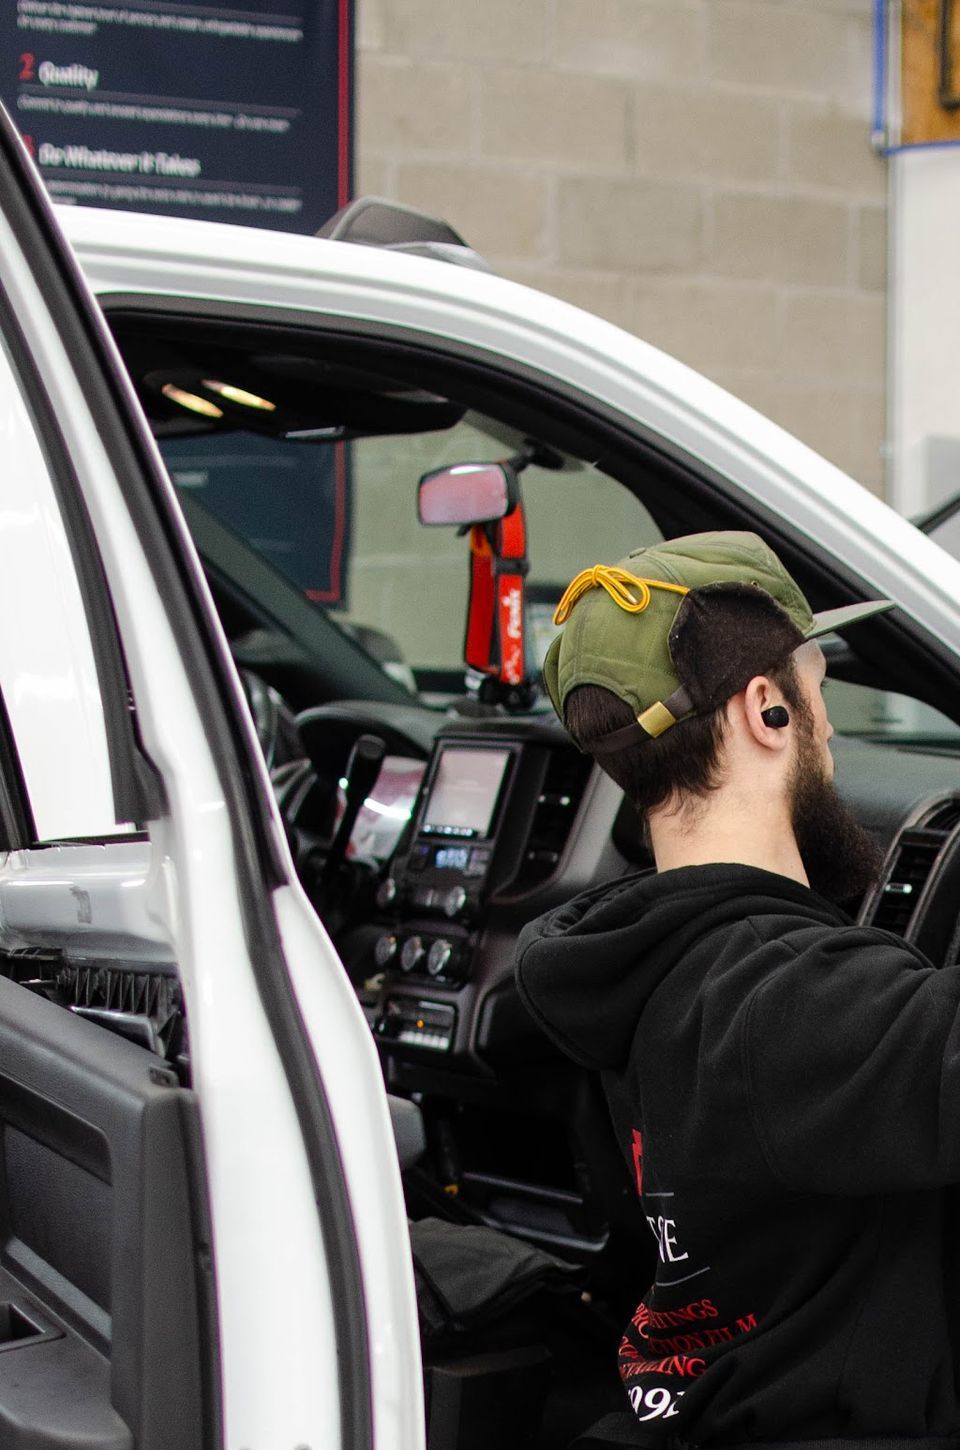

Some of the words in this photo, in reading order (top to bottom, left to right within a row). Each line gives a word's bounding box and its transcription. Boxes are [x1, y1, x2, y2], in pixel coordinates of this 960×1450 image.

[19, 53, 35, 80] 2
[39, 61, 99, 91] Quality
[39, 143, 62, 166] Do
[63, 146, 138, 172] Whatever
[155, 152, 201, 177] Takes
